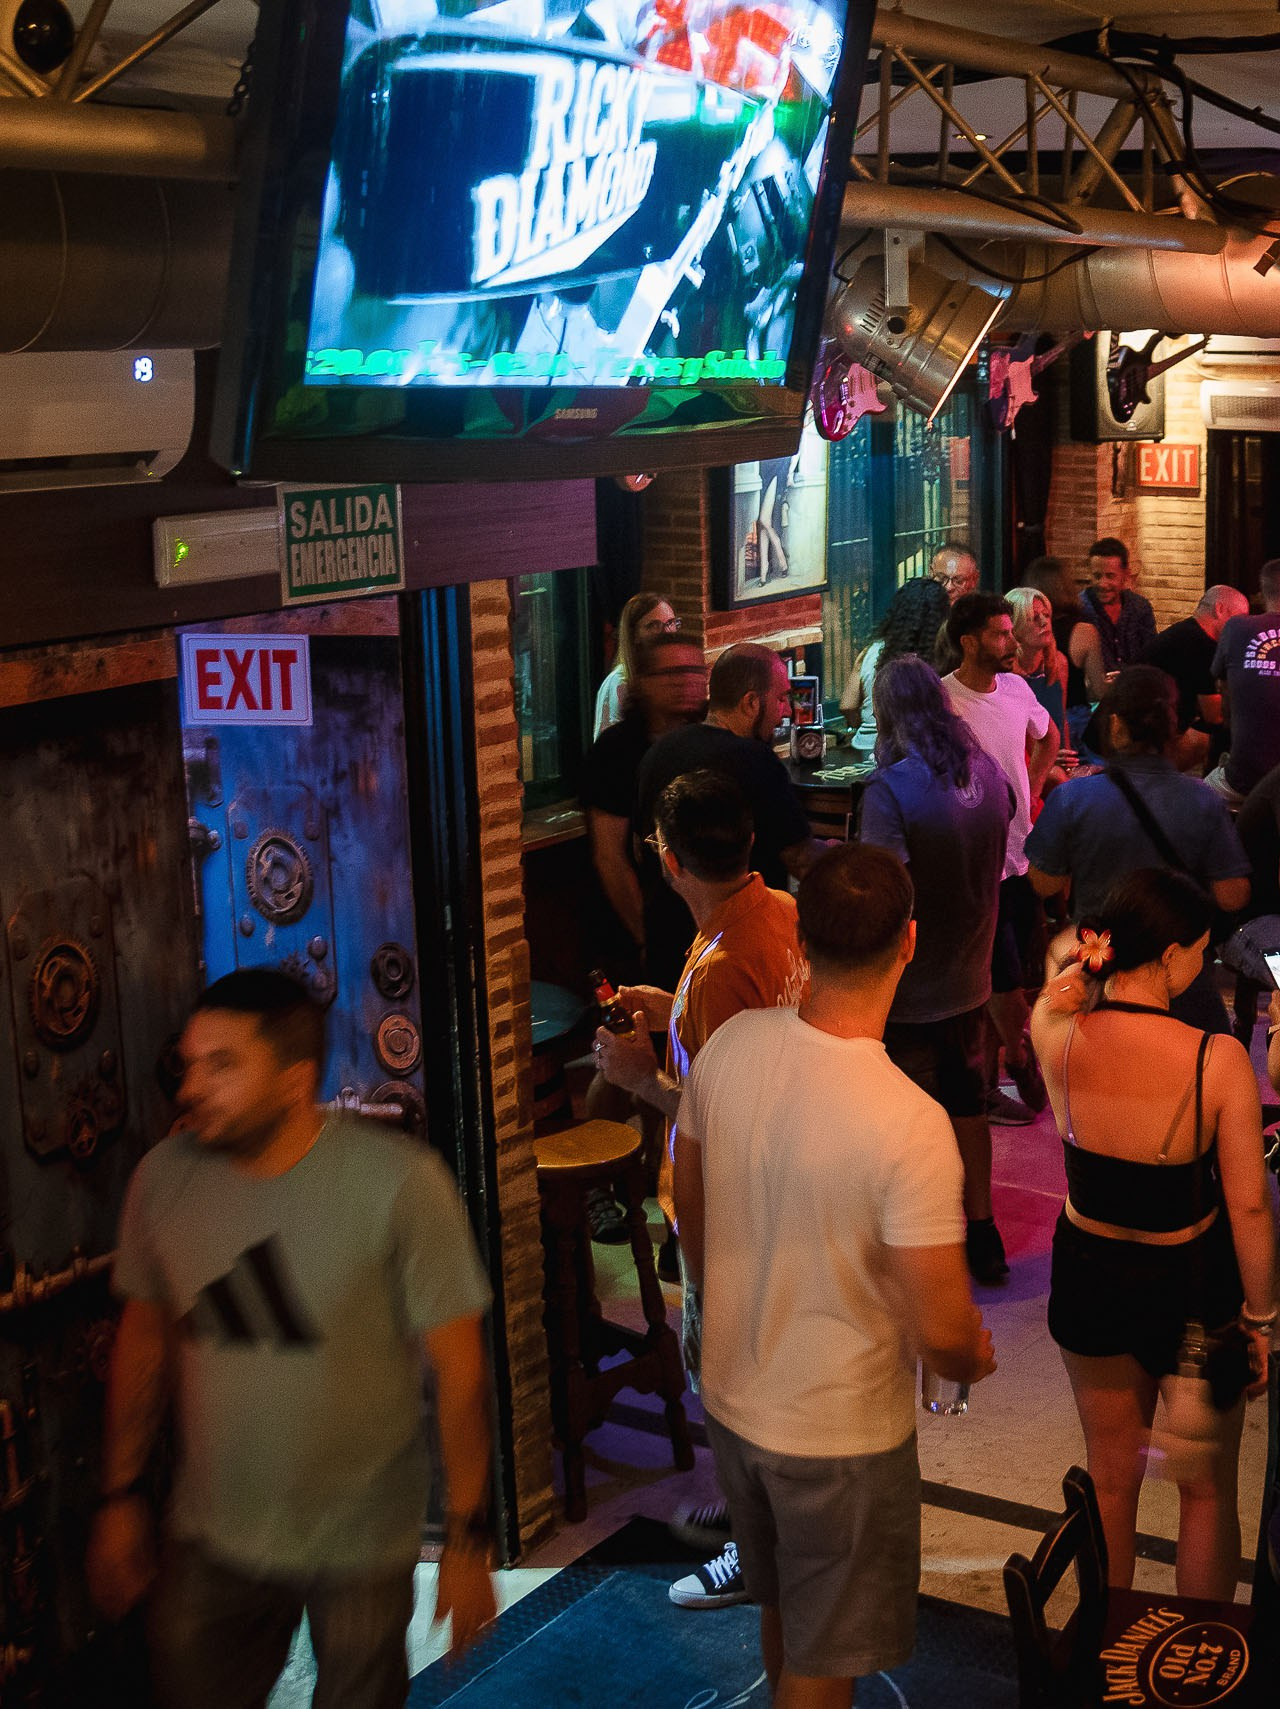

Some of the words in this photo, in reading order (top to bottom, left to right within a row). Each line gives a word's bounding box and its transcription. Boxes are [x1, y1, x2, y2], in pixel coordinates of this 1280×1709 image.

[528, 57, 657, 168] RICKY
[470, 142, 658, 285] DIAMOND
[1141, 448, 1195, 483] EXIT
[290, 493, 394, 538] SALIDA
[290, 532, 397, 588] EMERGENCIA
[196, 648, 298, 711] EXIT
[1159, 1643, 1197, 1679] Old
[1216, 1649, 1241, 1687] BRAND
[1102, 1664, 1146, 1706] JACK
